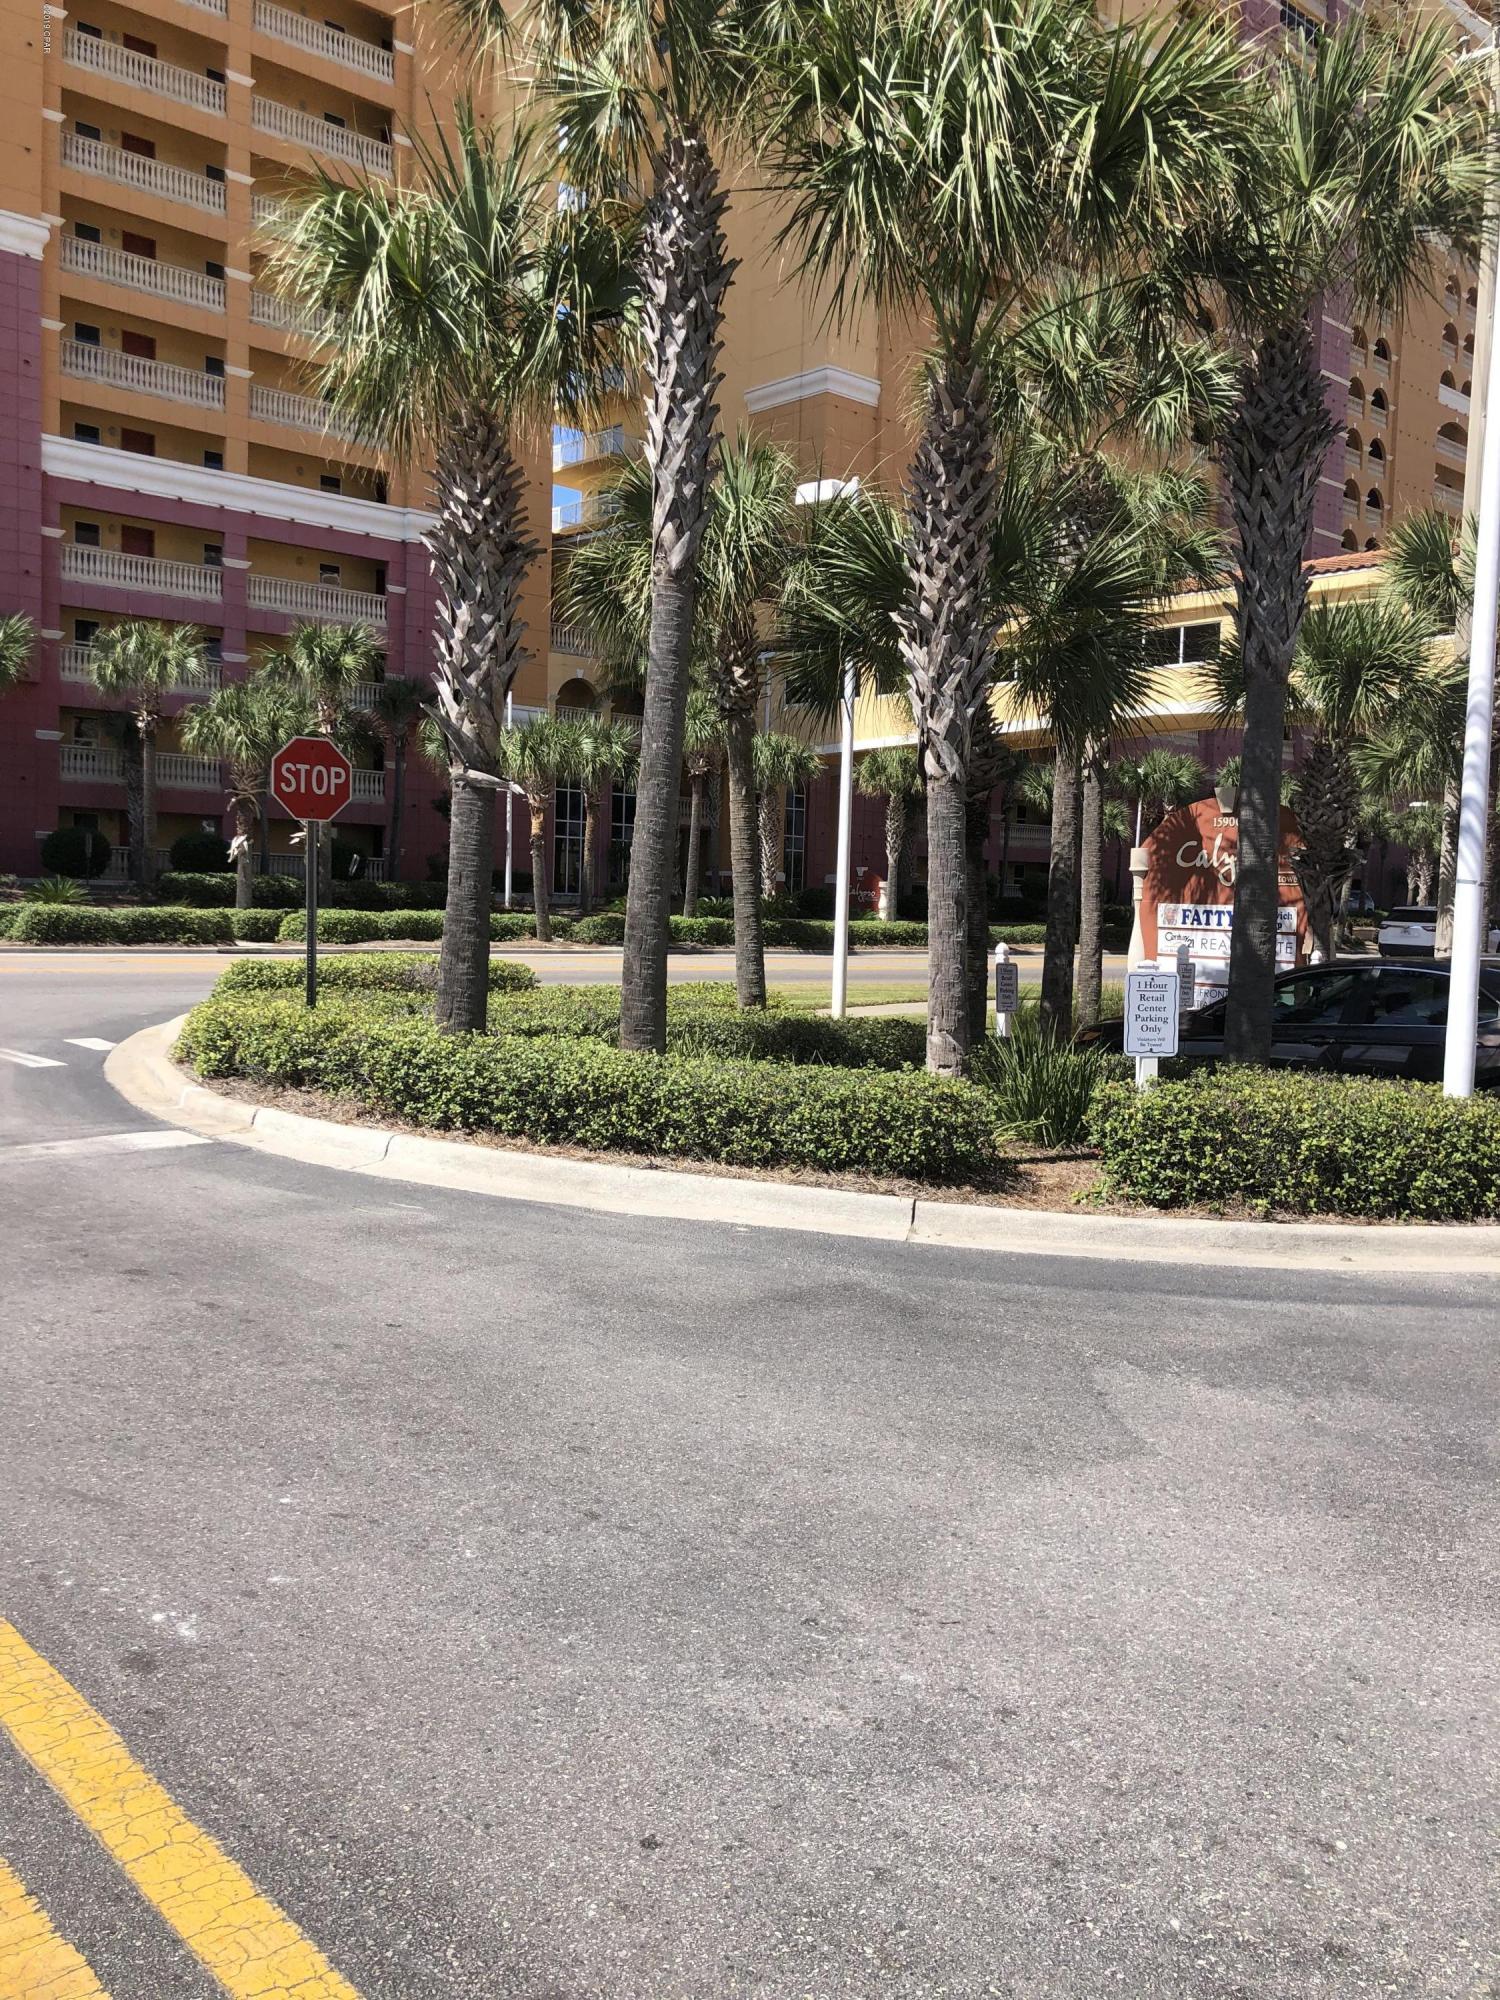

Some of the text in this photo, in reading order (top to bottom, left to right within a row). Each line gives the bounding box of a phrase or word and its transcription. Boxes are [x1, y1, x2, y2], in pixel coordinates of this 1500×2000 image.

[280, 762, 346, 796] STOP
[1187, 938, 1195, 949] 21
[1137, 981, 1168, 990] 1 Hour
[1139, 993, 1165, 1002] Retail
[1137, 1003, 1167, 1012] Center
[1135, 1013, 1169, 1024] Parking
[1140, 1024, 1162, 1035] Only
